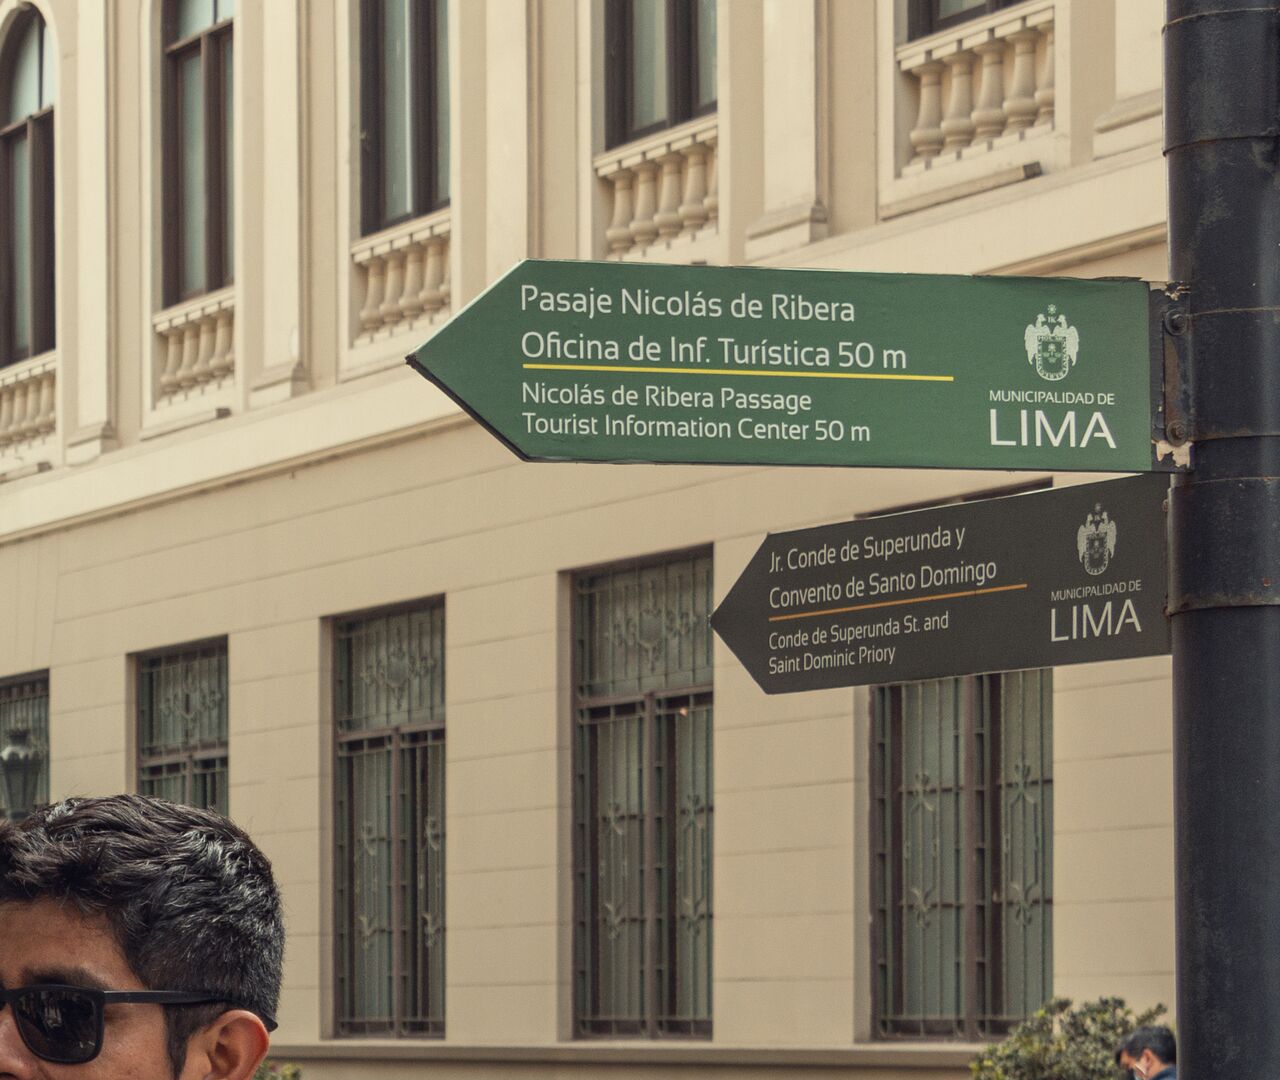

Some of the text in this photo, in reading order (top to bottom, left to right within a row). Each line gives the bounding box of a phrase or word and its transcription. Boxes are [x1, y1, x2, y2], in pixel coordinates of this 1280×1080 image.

[521, 284, 855, 322] Pasaje Nicolás de Ribera
[521, 330, 907, 369] Oficina de Inf. Turística 50 m
[522, 381, 812, 416] Nicolás de Ribera Passage
[989, 389, 1115, 406] MUNICIPALIDAD DE
[521, 411, 871, 442] Tourist Information Center 50 m
[989, 408, 1117, 449] LIMA
[768, 525, 966, 575] Jr. Conde de Superunda y
[769, 560, 997, 609] Convento de Santo Domingo
[1050, 579, 1142, 602] MUNICIPALIDAD DE
[768, 610, 949, 650] Conde de Superunda St. and
[1050, 598, 1143, 643] LIMA
[768, 646, 896, 675] Saint Dominic Priory
